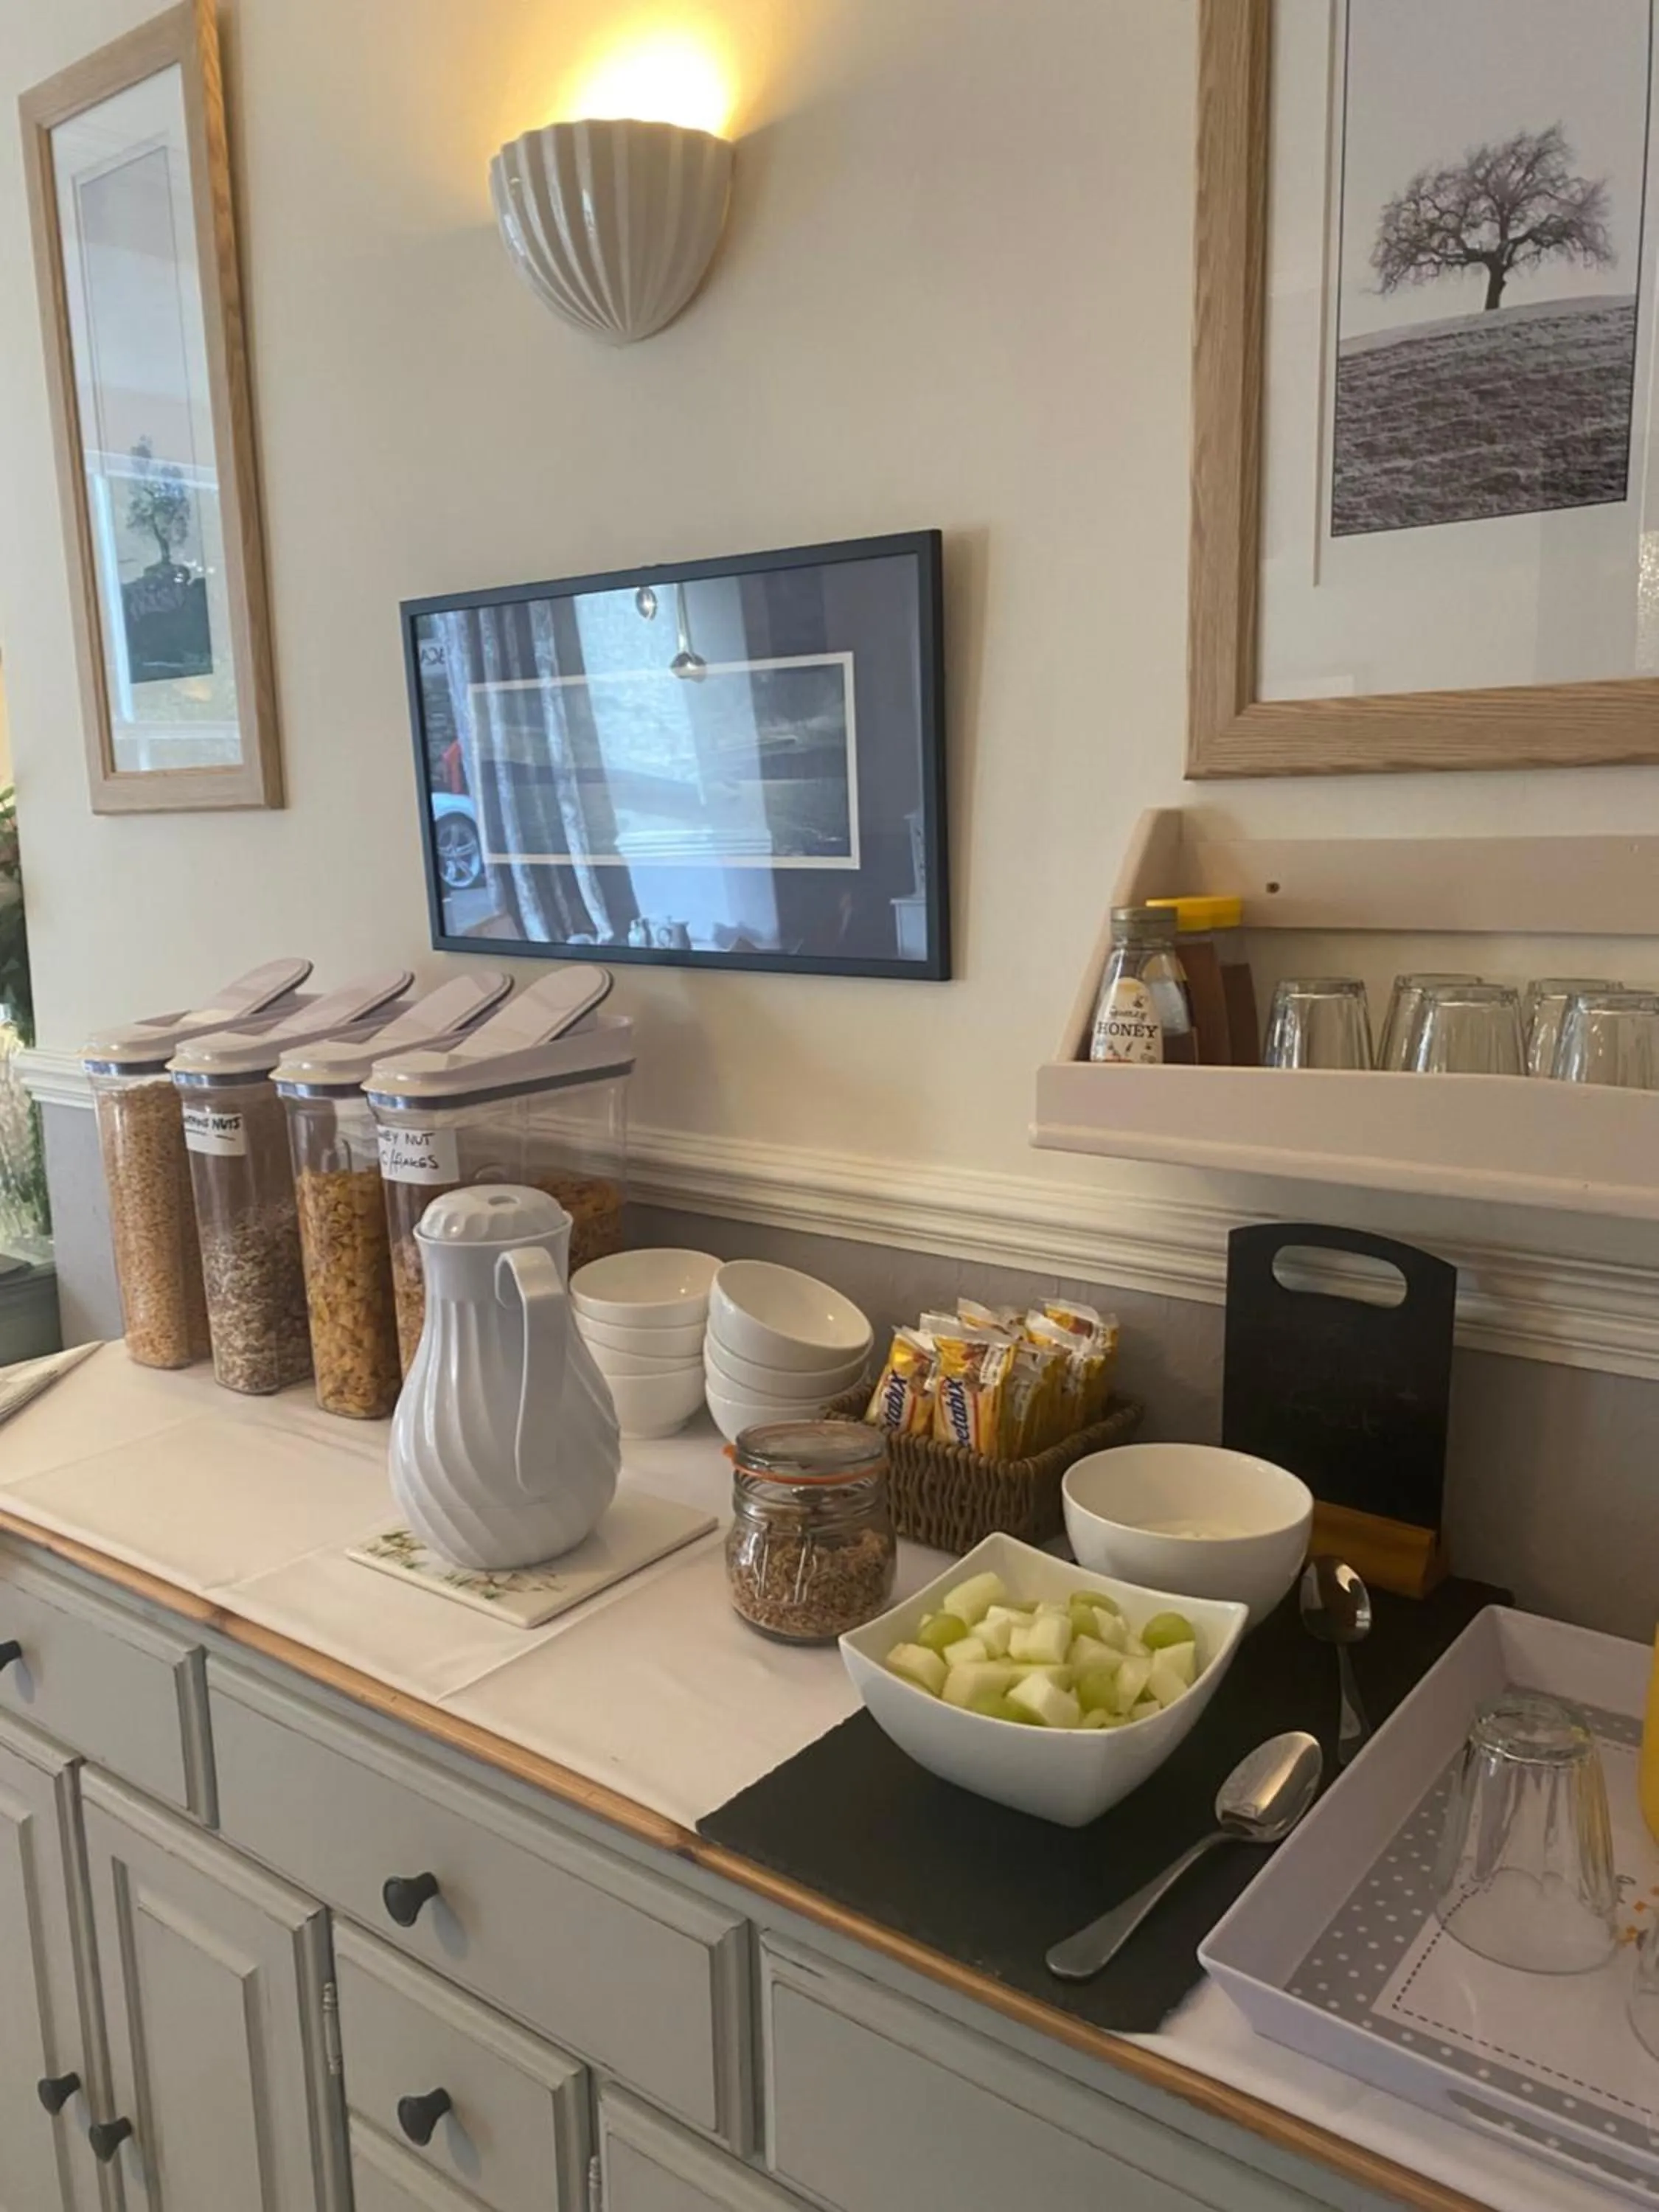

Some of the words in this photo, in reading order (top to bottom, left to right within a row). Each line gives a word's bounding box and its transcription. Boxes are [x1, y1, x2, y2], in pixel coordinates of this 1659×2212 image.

[1096, 1020, 1158, 1039] HONEY
[212, 1116, 242, 1131] NUTS
[403, 1132, 436, 1146] NUT
